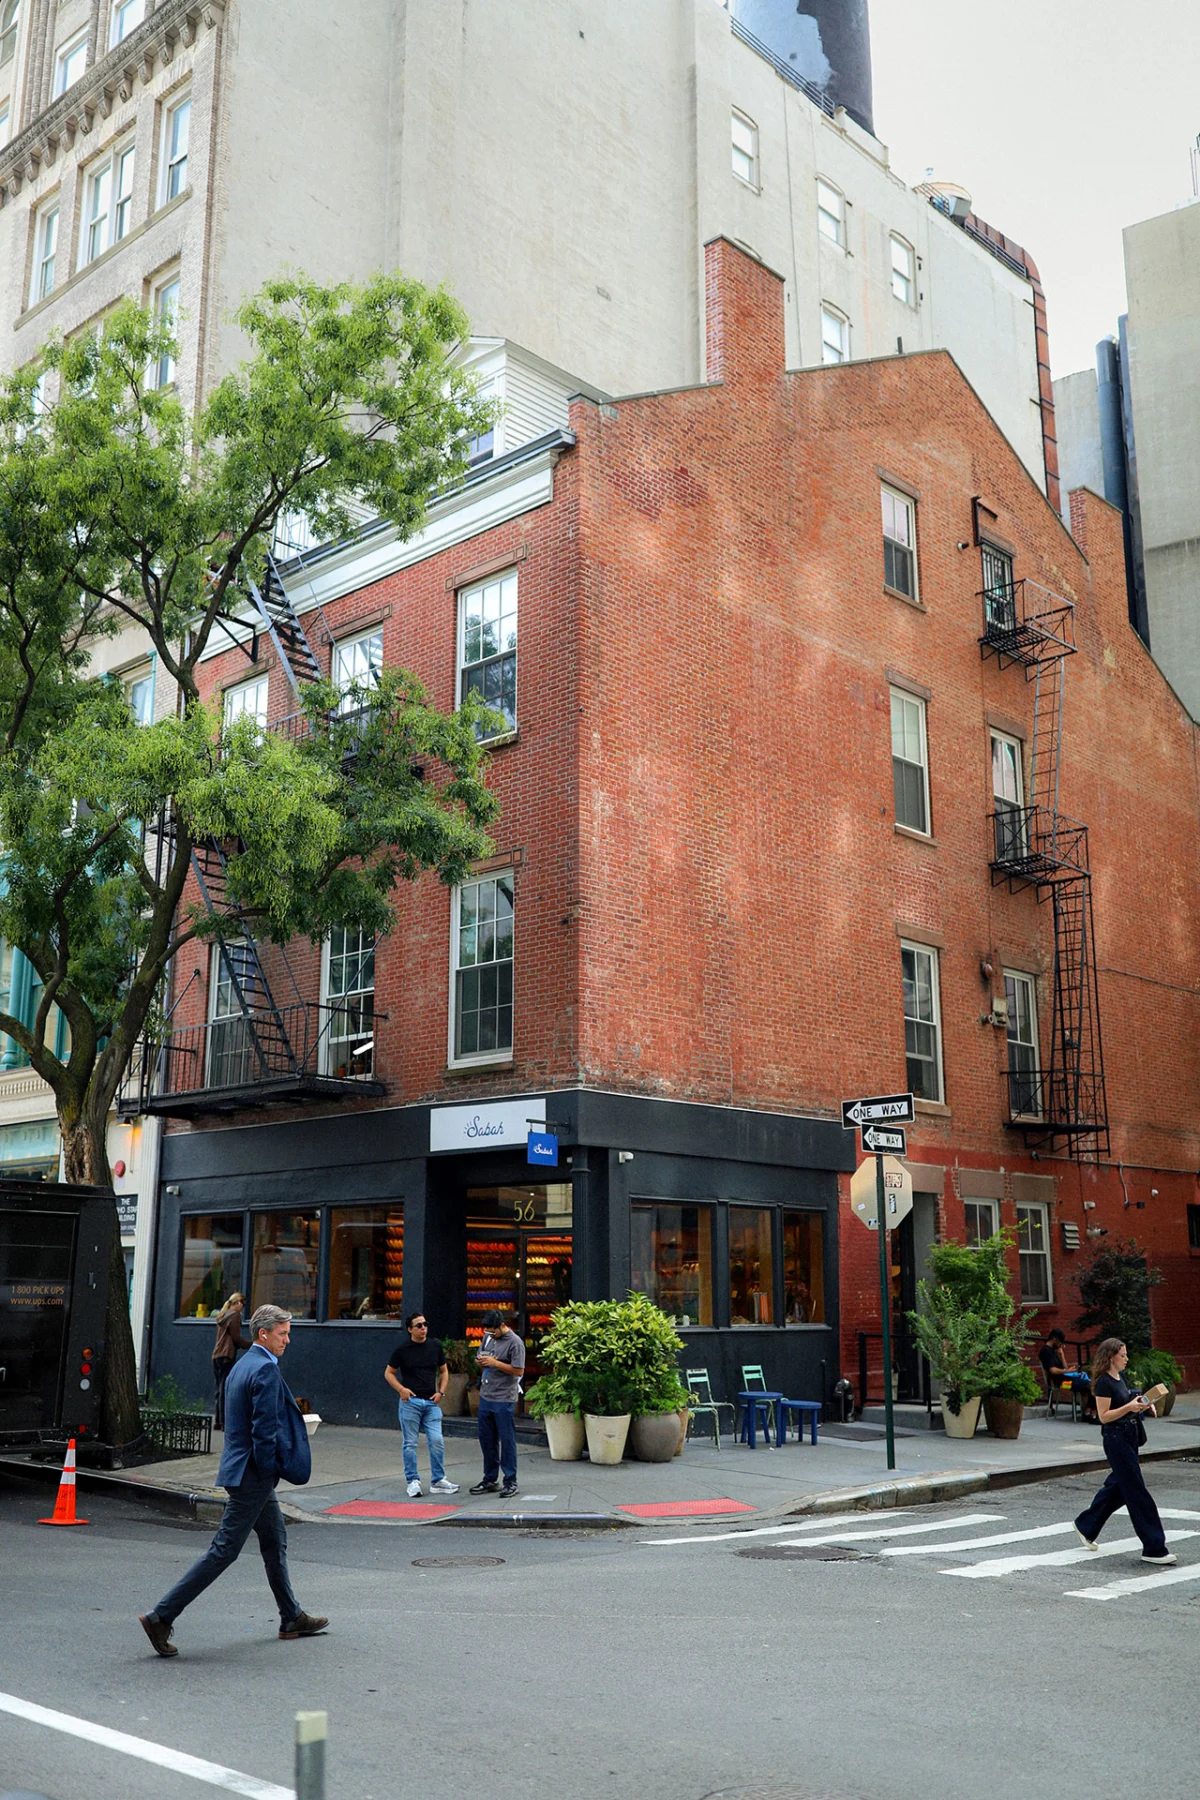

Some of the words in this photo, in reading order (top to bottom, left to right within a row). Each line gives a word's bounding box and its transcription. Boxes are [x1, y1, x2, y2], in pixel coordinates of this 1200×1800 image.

[852, 1106, 873, 1119] ONE
[881, 1103, 904, 1116] WAY
[465, 1115, 504, 1138] Sabah
[868, 1132, 881, 1144] ONE
[885, 1135, 900, 1146] WAY
[513, 1199, 535, 1222] 56
[16, 1285, 31, 1294] 800
[32, 1285, 49, 1294] PICK
[50, 1286, 65, 1295] UPS
[10, 1297, 63, 1307] www.ups.com
